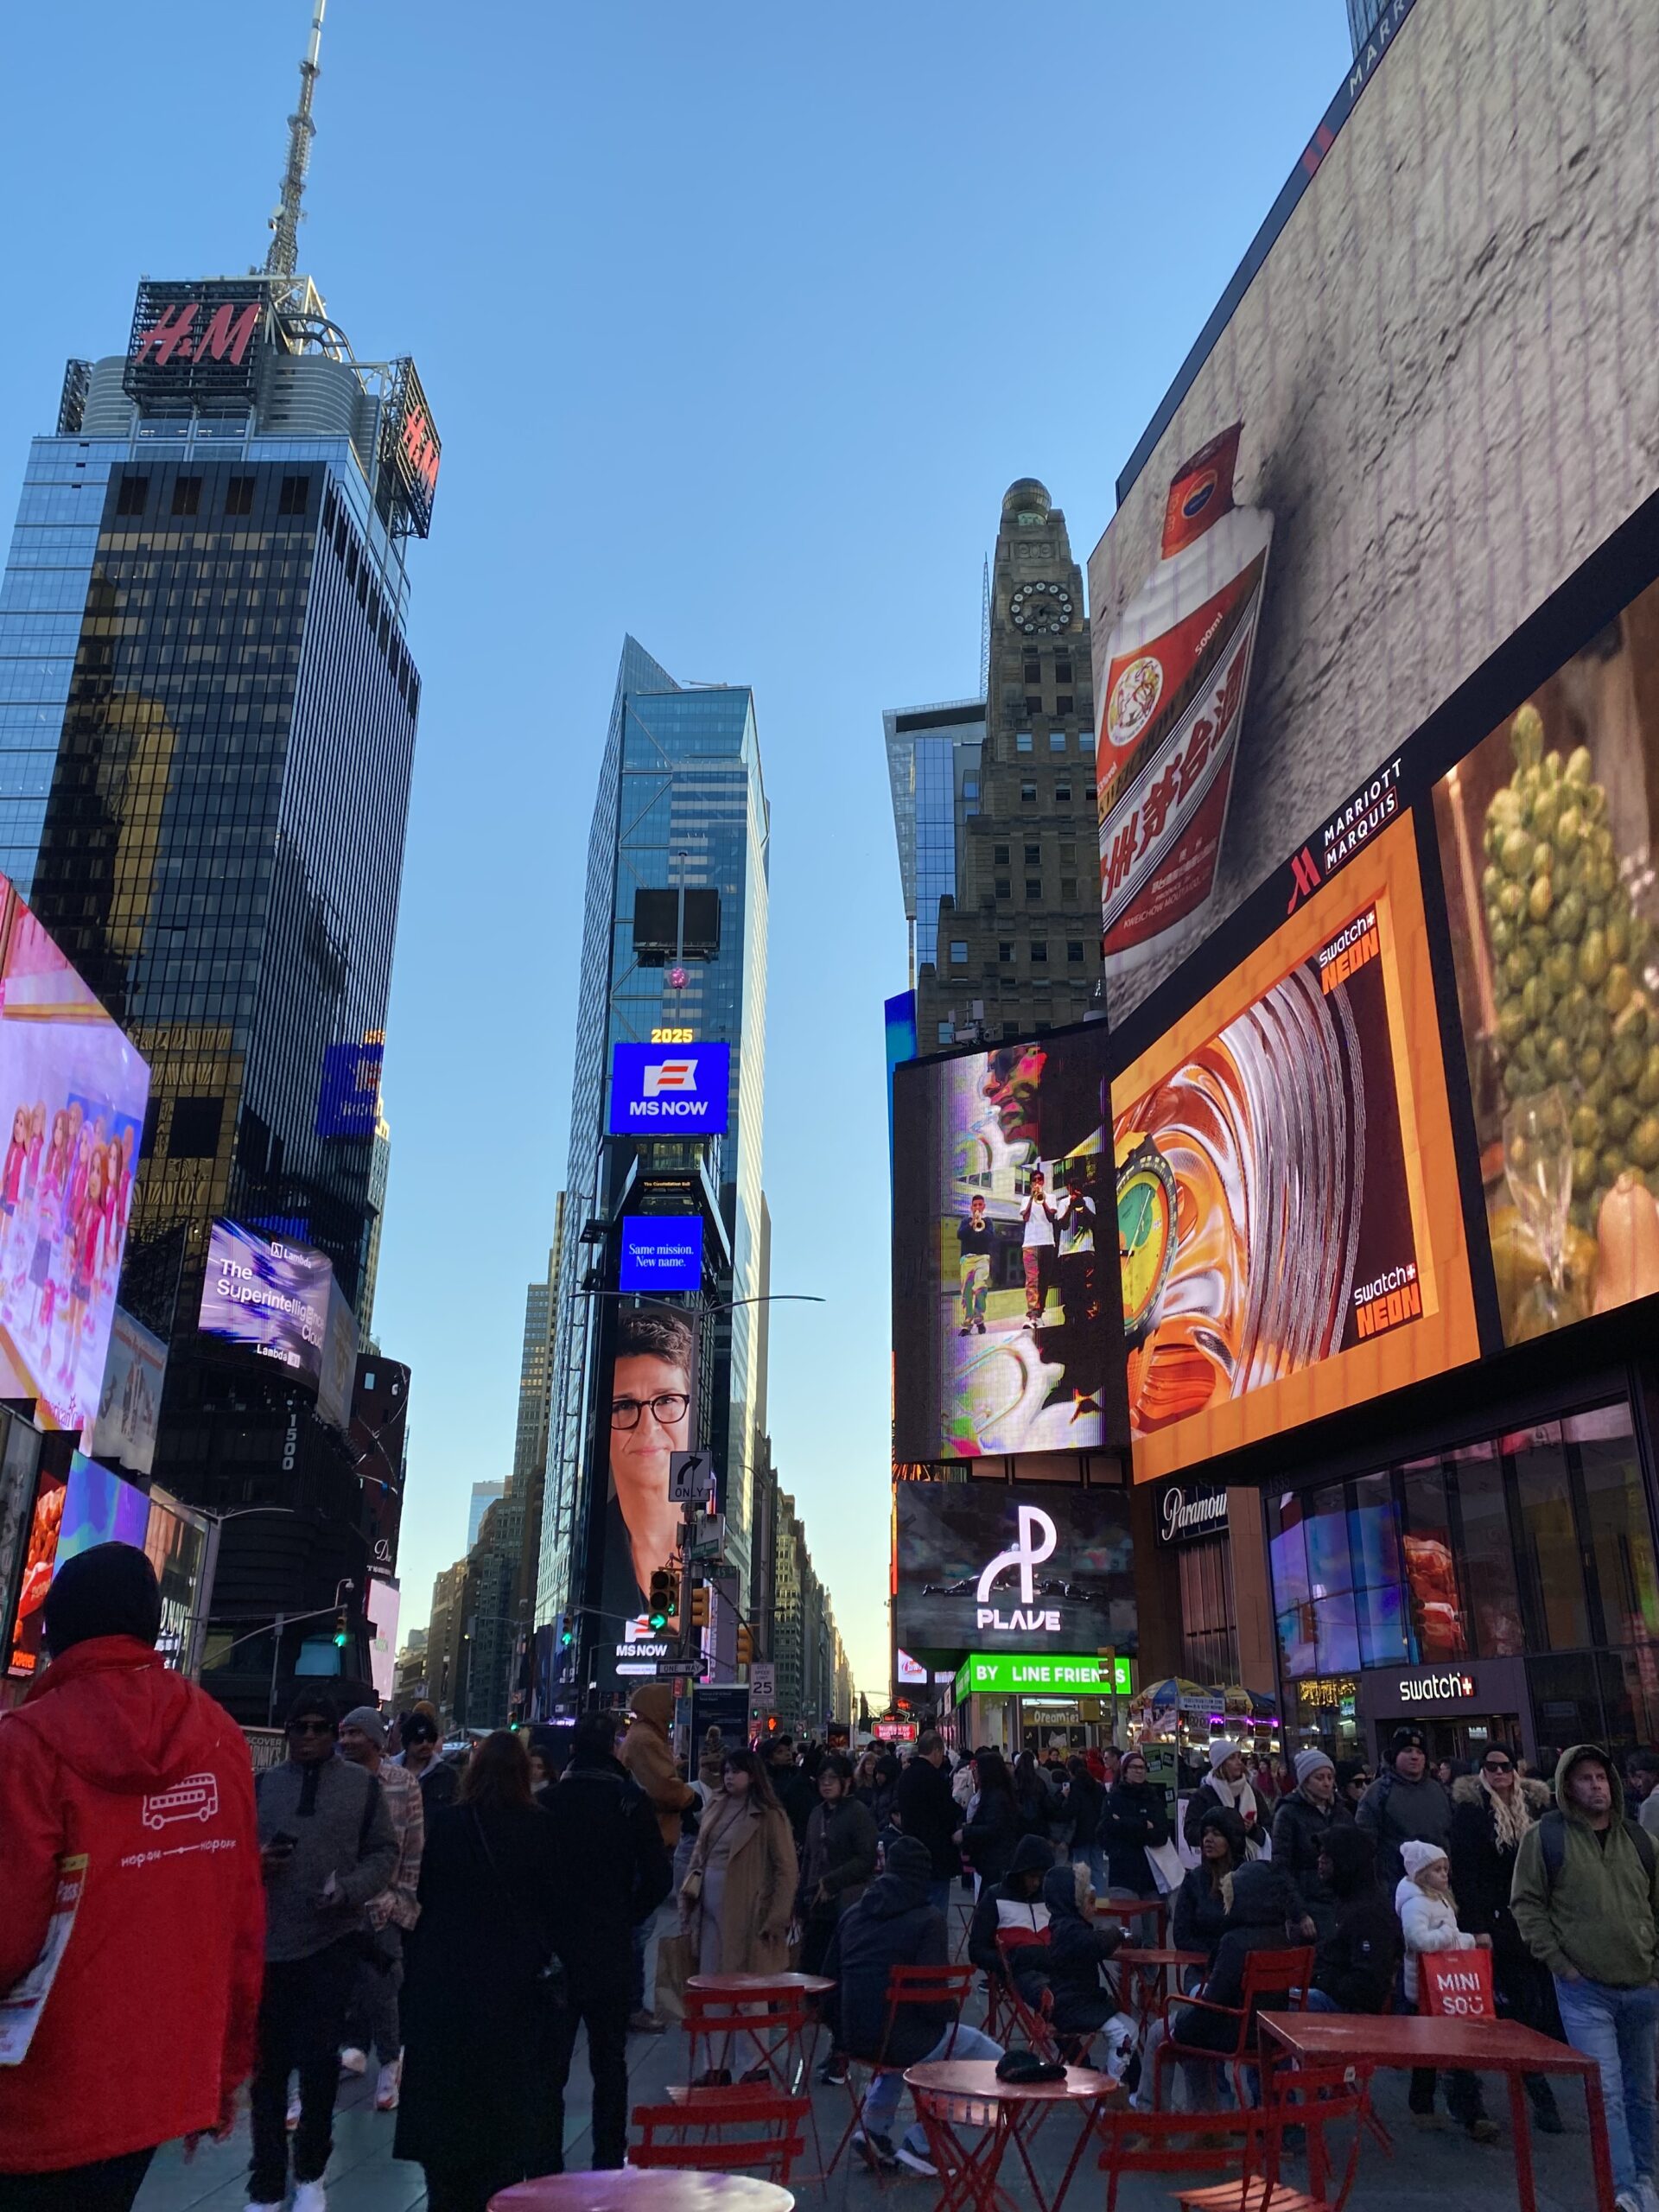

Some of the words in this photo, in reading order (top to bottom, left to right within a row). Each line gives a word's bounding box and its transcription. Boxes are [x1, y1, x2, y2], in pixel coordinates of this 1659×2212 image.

[134, 303, 262, 366] H&M
[1195, 612, 1224, 657] 500ml
[1325, 757, 1402, 848] MARRIOTT
[1326, 792, 1395, 870] MARQUIS
[1319, 918, 1367, 968] swatch
[1321, 926, 1380, 996] NEON
[651, 1028, 693, 1044] 2025
[629, 1101, 659, 1116] MS
[661, 1101, 709, 1116] NOW
[284, 1249, 312, 1269] Lambda
[629, 1243, 655, 1255] Same
[657, 1243, 695, 1255] mission.
[220, 1258, 253, 1281] The
[636, 1255, 657, 1268] New
[658, 1257, 687, 1268] name.
[1354, 1266, 1407, 1306] swatch
[1357, 1281, 1421, 1339] NEON
[257, 1344, 288, 1363] Lambda
[282, 1414, 298, 1471] 1500
[675, 1487, 703, 1498] ONLY
[976, 1608, 1062, 1631] PLAVE
[616, 1644, 637, 1656] MS
[637, 1644, 668, 1656] NOW
[684, 1663, 701, 1673] WAY
[976, 1665, 999, 1681] BY
[1012, 1666, 1051, 1682] LINE
[1053, 1667, 1126, 1684] FRIENS
[753, 1681, 772, 1694] 25
[1399, 1672, 1462, 1701] swatch
[146, 1850, 162, 1860] ON
[220, 1840, 237, 1849] OFF
[1436, 1972, 1481, 1992] MINI
